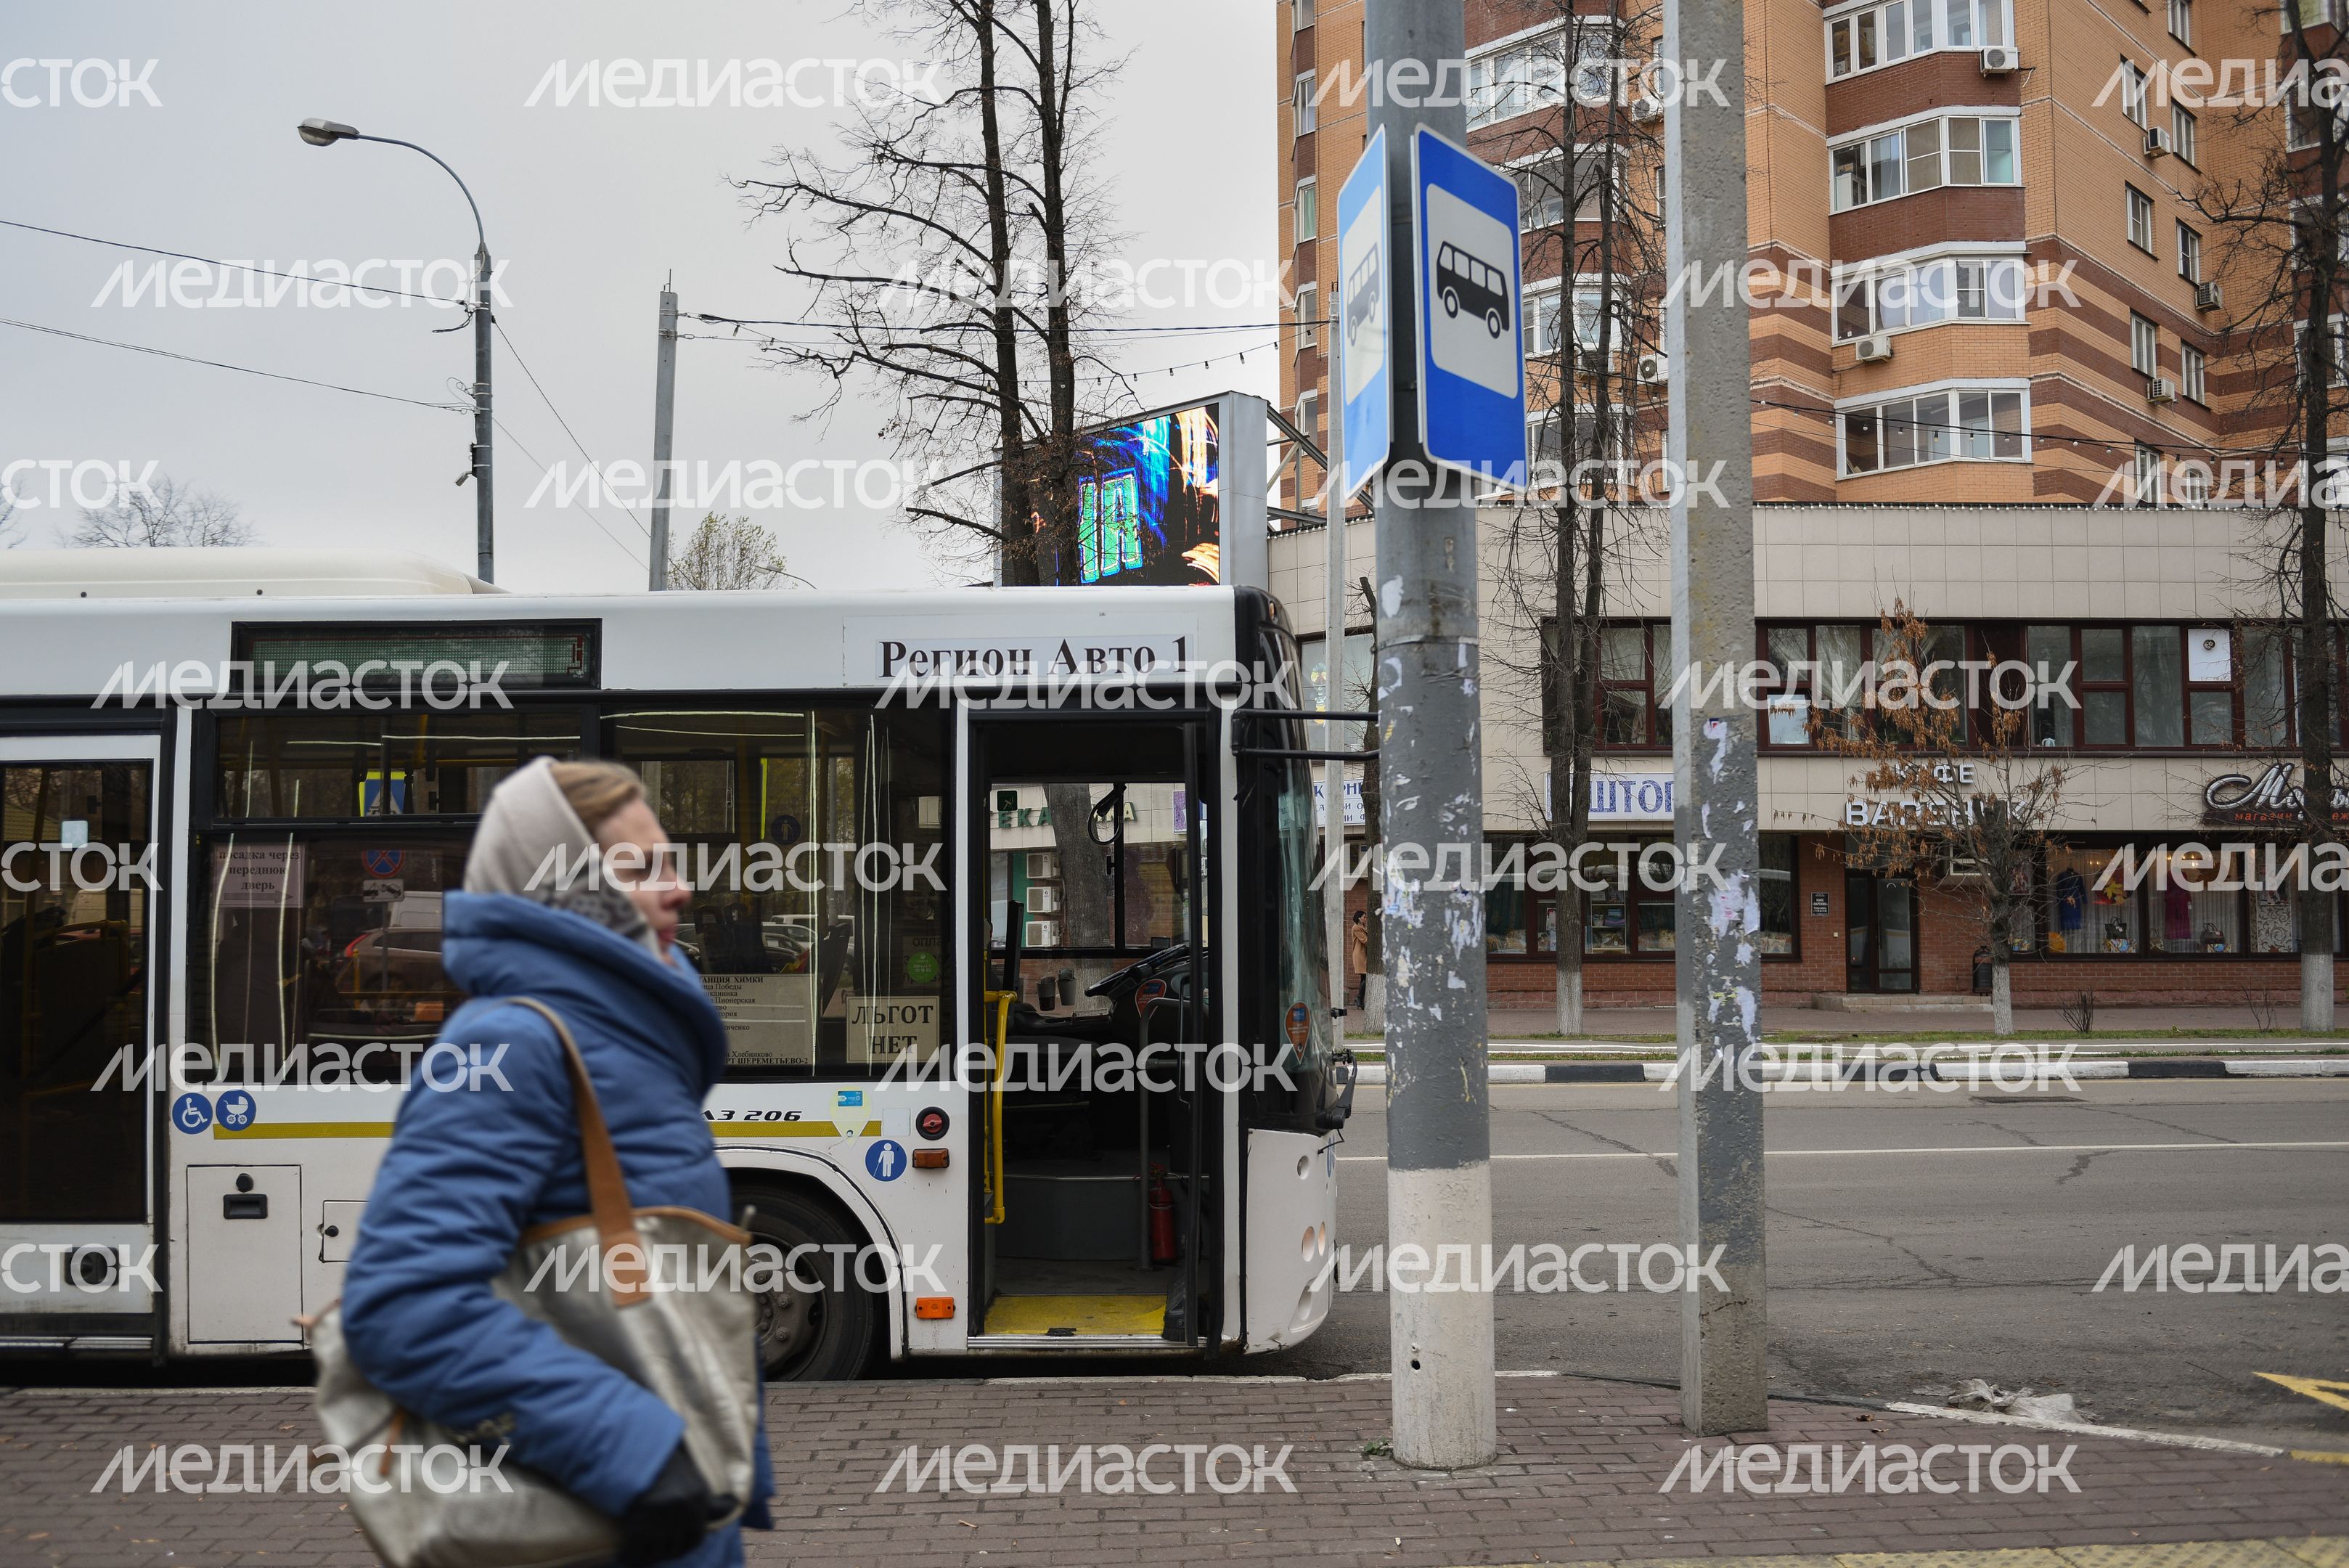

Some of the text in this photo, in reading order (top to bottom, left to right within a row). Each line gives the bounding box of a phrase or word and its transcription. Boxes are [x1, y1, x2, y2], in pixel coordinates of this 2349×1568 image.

[878, 636, 1191, 677] Регион Авто 1
[241, 881, 275, 892] дверь
[852, 1005, 934, 1025] ЛЬГОТ
[870, 1035, 917, 1054] НЕТ
[743, 1110, 802, 1121] 206
